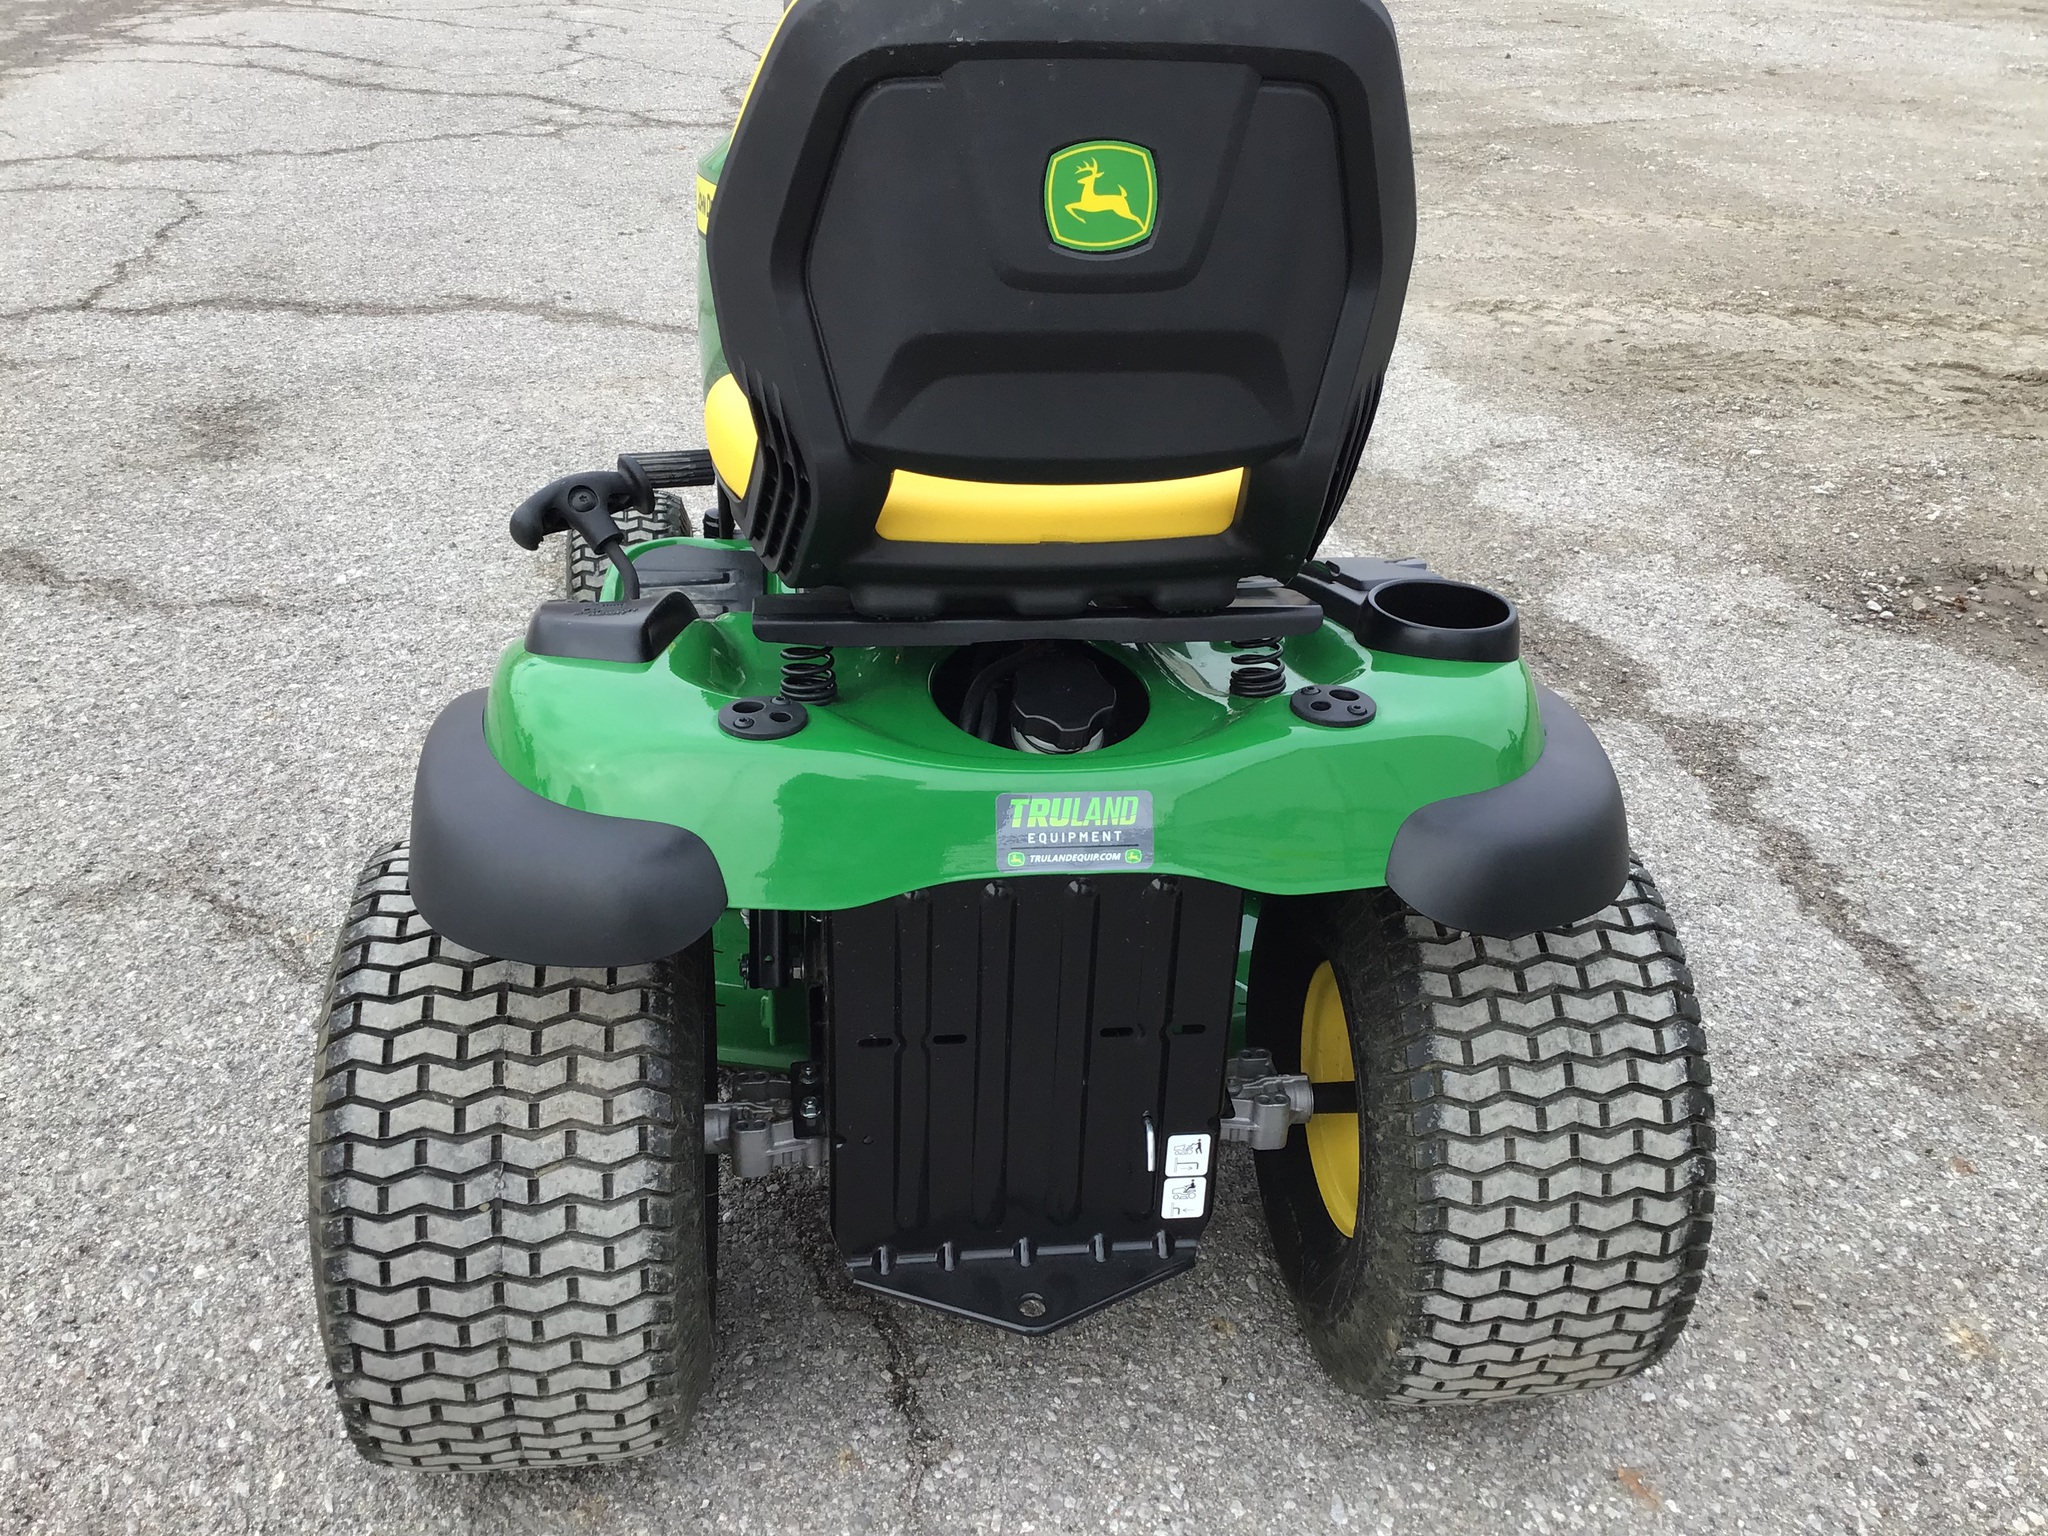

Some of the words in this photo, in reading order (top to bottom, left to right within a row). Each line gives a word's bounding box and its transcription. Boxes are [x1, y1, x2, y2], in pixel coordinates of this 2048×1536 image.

[1010, 796, 1139, 828] TRULAND
[1027, 830, 1123, 844] EQUIPMENT
[1029, 852, 1121, 863] TRULANDEQUIP.COM
